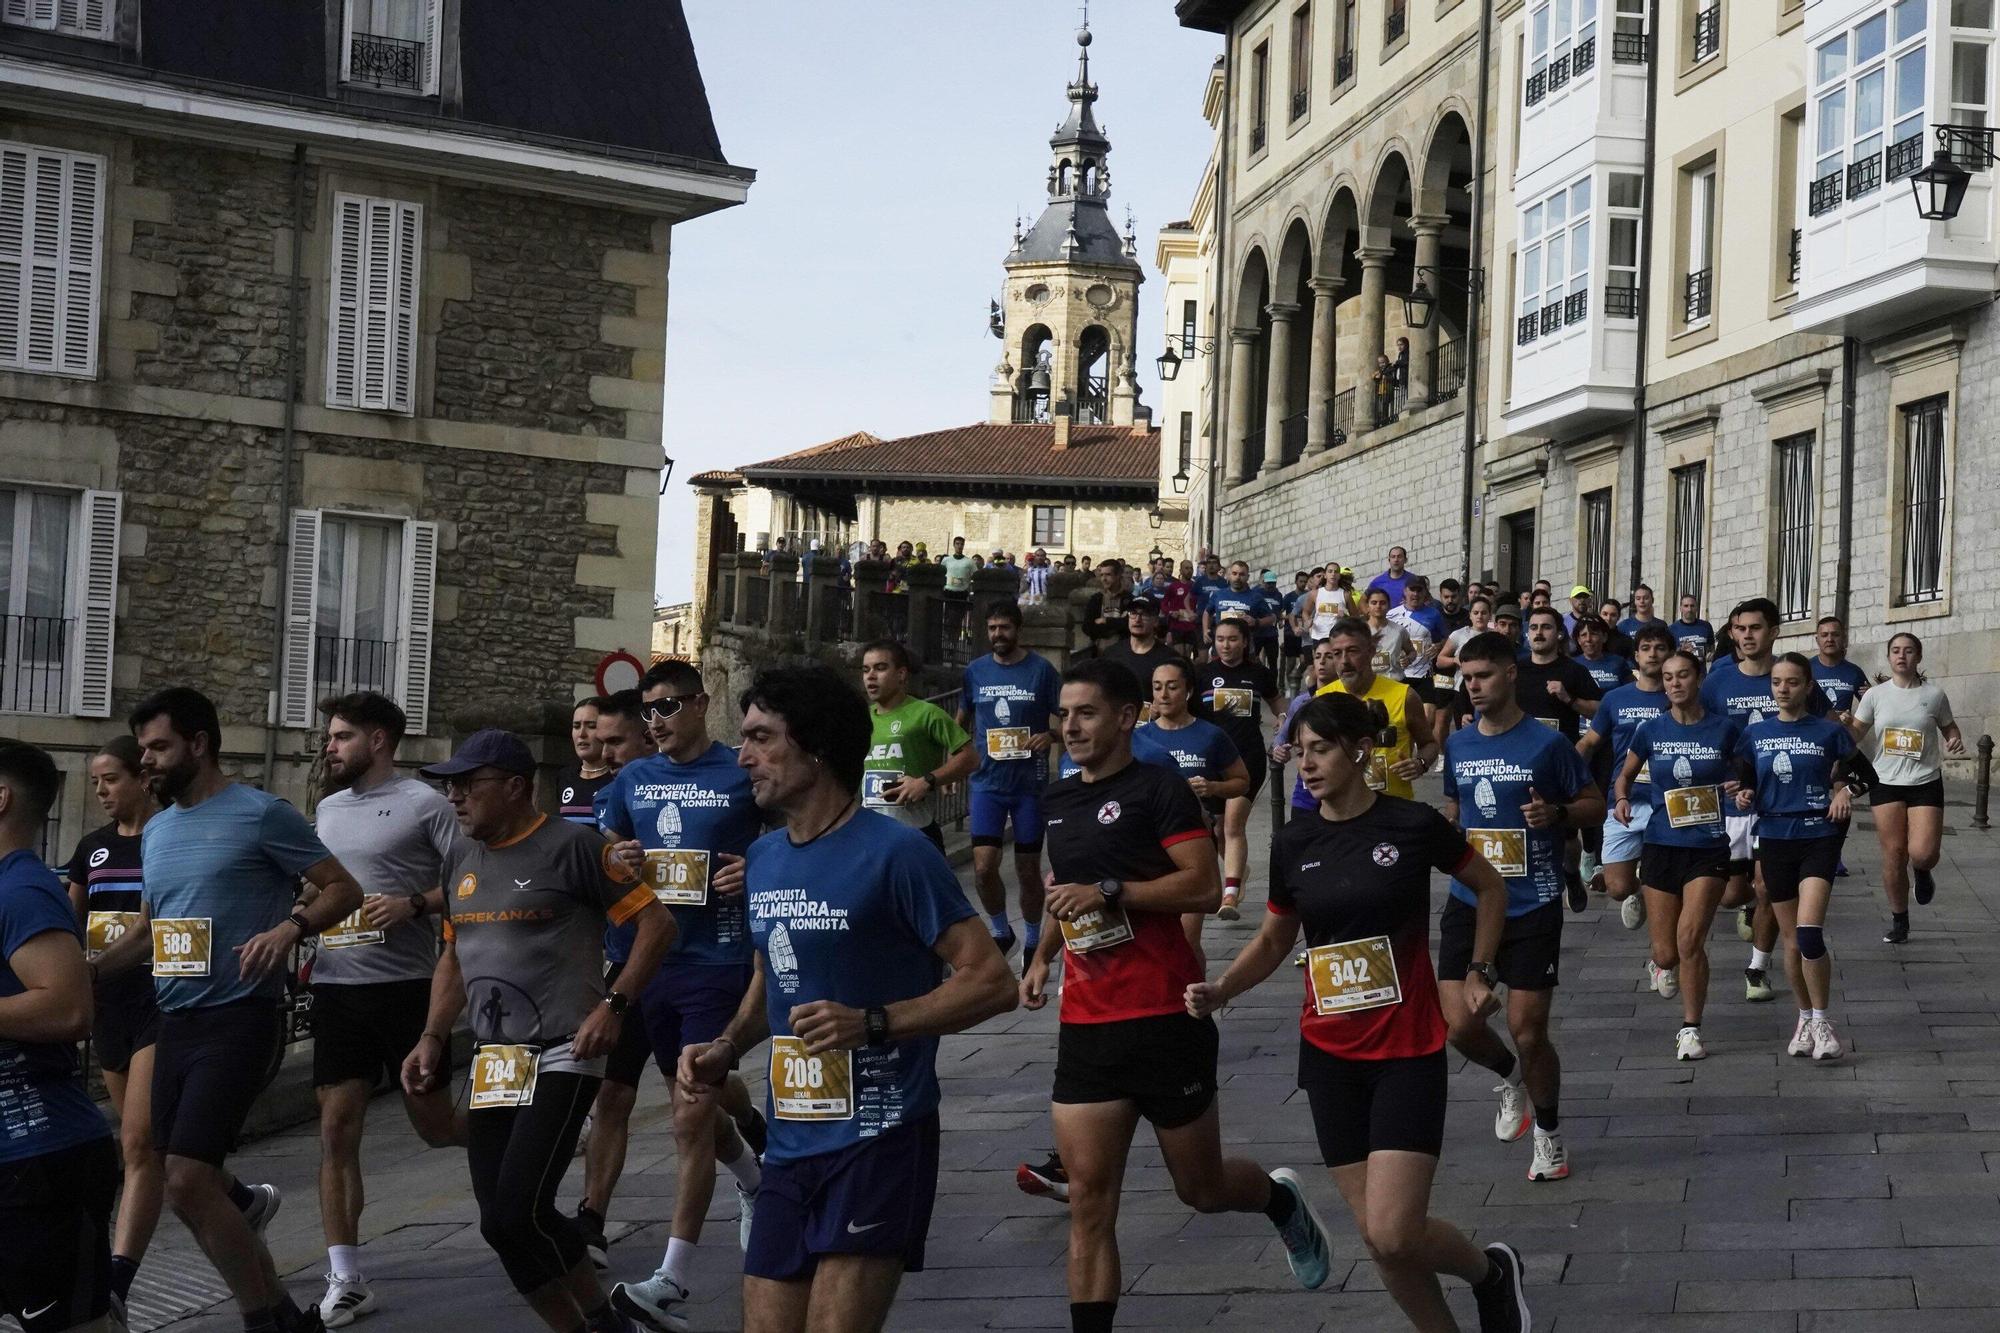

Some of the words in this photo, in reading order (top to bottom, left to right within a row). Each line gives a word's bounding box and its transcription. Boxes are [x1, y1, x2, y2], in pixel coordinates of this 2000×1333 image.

[1737, 700, 1779, 709] ALMENDR
[1000, 735, 1018, 748] 221
[1762, 737, 1792, 745] CONQUISTA
[1763, 742, 1816, 751] ALMENDRA
[1896, 735, 1912, 748] 161
[1662, 746, 1715, 755] ALMENDRA
[1790, 749, 1825, 757] KONKISTA
[1462, 759, 1506, 769] CONQUISTA
[1463, 765, 1521, 777] ALMENDRA
[1493, 774, 1534, 782] KONKISTA
[635, 784, 644, 792] LA
[645, 783, 698, 792] CONQUISTA
[644, 789, 717, 801] ALMENDRA
[681, 799, 731, 808] KONKISTA
[1684, 796, 1701, 811] 72
[1483, 840, 1505, 859] 64
[656, 862, 688, 884] 516
[751, 892, 758, 903] LA
[758, 888, 807, 903] CONQUISTA
[756, 900, 830, 919] ALMENDRA
[830, 908, 848, 917] REN
[789, 918, 850, 931] KONKISTA
[162, 932, 193, 955] 588
[1371, 941, 1385, 952] 10K
[779, 973, 800, 981] VITORIA
[1329, 956, 1371, 988] 342
[779, 980, 801, 988] GASTEIZ
[485, 1058, 516, 1084] 284
[783, 1056, 824, 1089] 208
